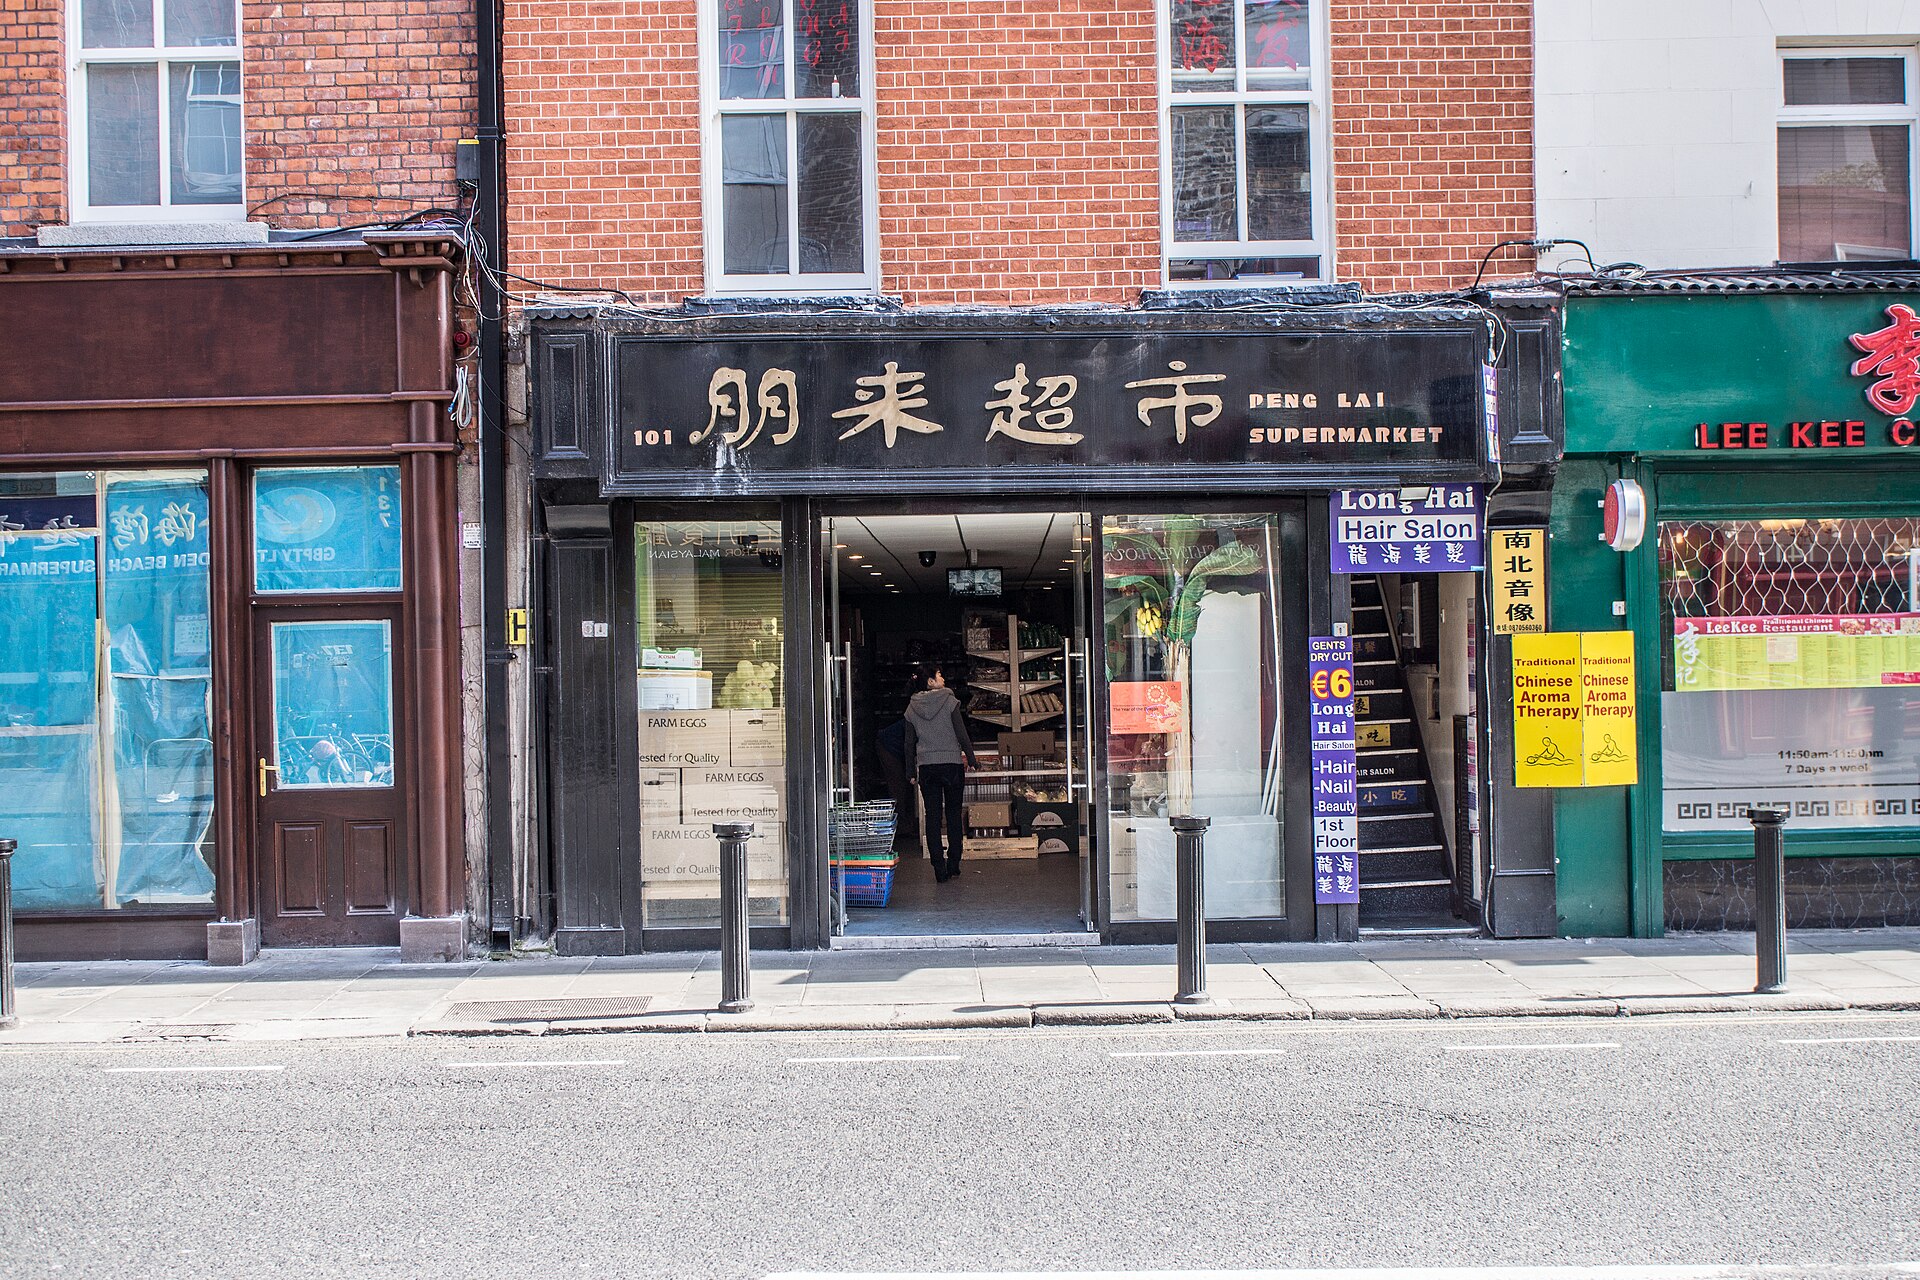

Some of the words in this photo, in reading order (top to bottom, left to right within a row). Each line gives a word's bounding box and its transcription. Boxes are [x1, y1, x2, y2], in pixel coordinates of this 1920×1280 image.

[1250, 393, 1317, 409] PENG
[1338, 392, 1385, 408] LAI
[633, 430, 672, 446] 101
[1250, 427, 1443, 443] SUPERMARKET
[1699, 422, 1768, 449] LEE
[1790, 421, 1866, 448] KEE
[1424, 486, 1474, 508] Hai
[1345, 520, 1397, 540] Hair
[1404, 519, 1472, 539] Salon
[1503, 532, 1535, 621] 南北音像
[1706, 621, 1757, 633] LeeKee
[1762, 617, 1803, 625] Traditional
[1763, 624, 1833, 632] Restaurant
[1312, 641, 1346, 650] GENTS
[1310, 652, 1330, 661] DRY
[1332, 652, 1352, 661] CUT
[1514, 658, 1575, 666] Traditional
[1583, 657, 1631, 665] Traditional
[1312, 668, 1352, 699] €6
[1515, 675, 1573, 687] Chinese
[1583, 674, 1629, 687] Chinese
[1520, 691, 1570, 703] Aroma
[1587, 690, 1627, 702] Aroma
[1312, 702, 1354, 718] Long
[1516, 705, 1580, 720] Therapy
[1584, 704, 1634, 718] Therapy
[648, 718, 677, 728] FARM
[680, 718, 707, 728] EGGS
[1317, 721, 1347, 734] Hai
[1313, 742, 1330, 750] Hair
[1332, 742, 1355, 750] Salon
[668, 752, 682, 762] for
[685, 752, 720, 765] Quality
[1369, 768, 1395, 776] SALON
[1785, 764, 1792, 774] 7
[1796, 764, 1826, 775] Days
[705, 772, 734, 782] FARM
[737, 772, 764, 782] EGGS
[1363, 789, 1407, 803] 小吃
[692, 807, 724, 817] Tested
[726, 807, 740, 817] for
[742, 806, 778, 818] Quality
[1319, 819, 1345, 832] 1st
[652, 830, 681, 840] FARM
[684, 830, 711, 840] EGGS
[1316, 835, 1356, 848] Floor
